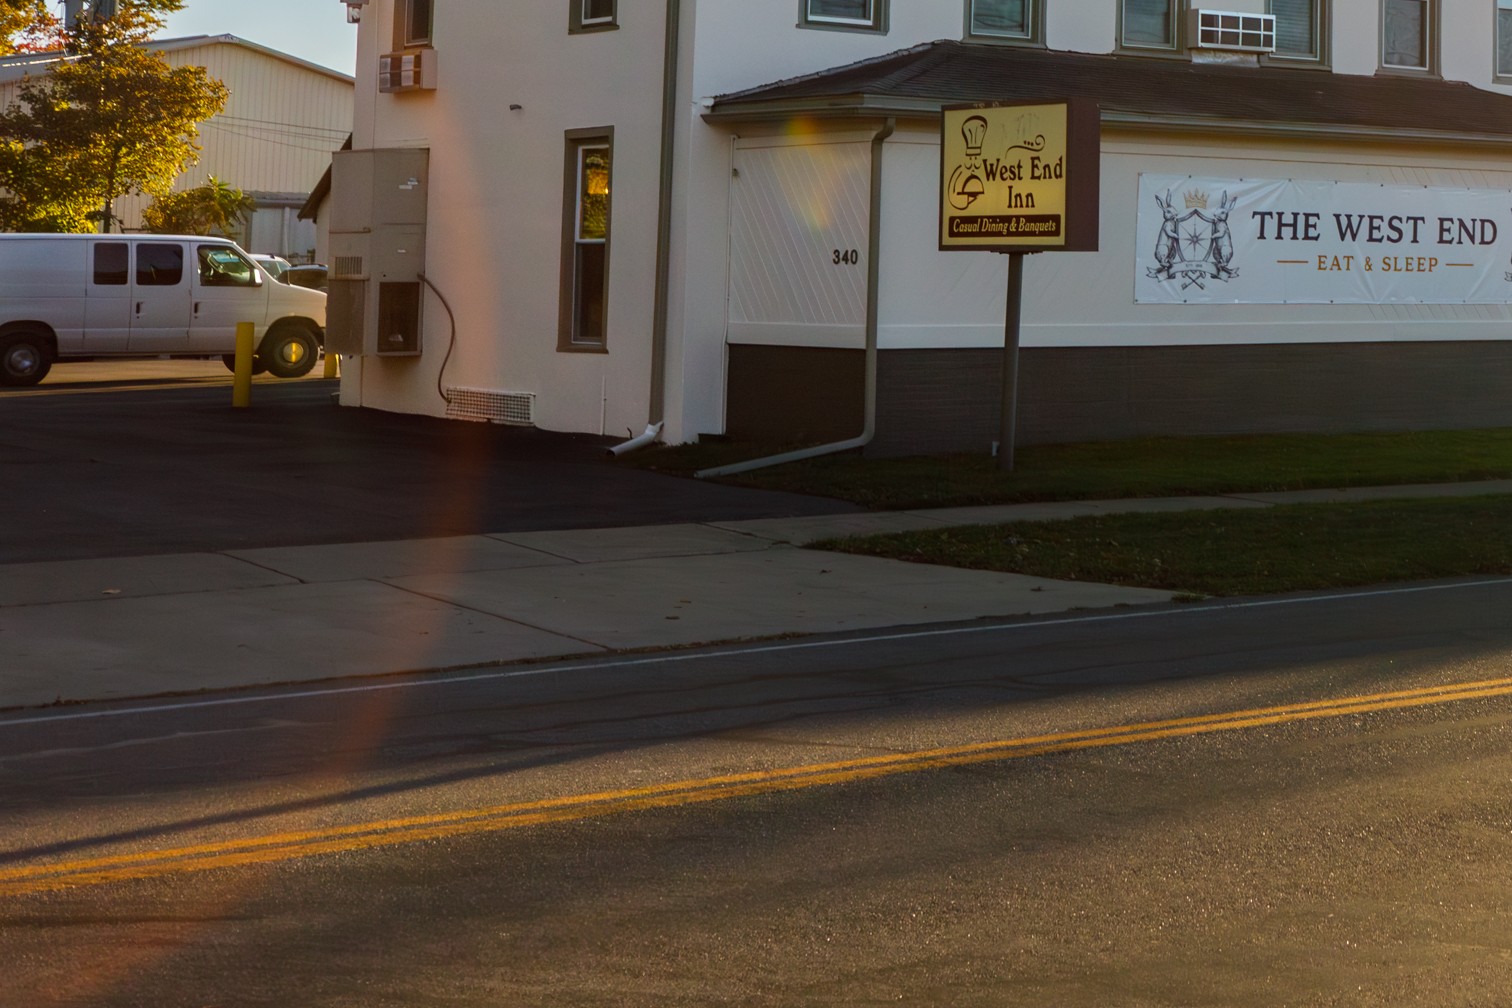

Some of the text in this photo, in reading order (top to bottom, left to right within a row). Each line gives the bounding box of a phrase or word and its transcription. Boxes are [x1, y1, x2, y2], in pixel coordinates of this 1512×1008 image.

[982, 155, 1063, 182] West End
[1007, 185, 1036, 209] Inn
[953, 216, 1056, 235] Casual Dining & Banquets
[1251, 210, 1498, 246] THE WEST END
[832, 249, 858, 265] 340
[1316, 254, 1439, 273] EAT & SLEEP
